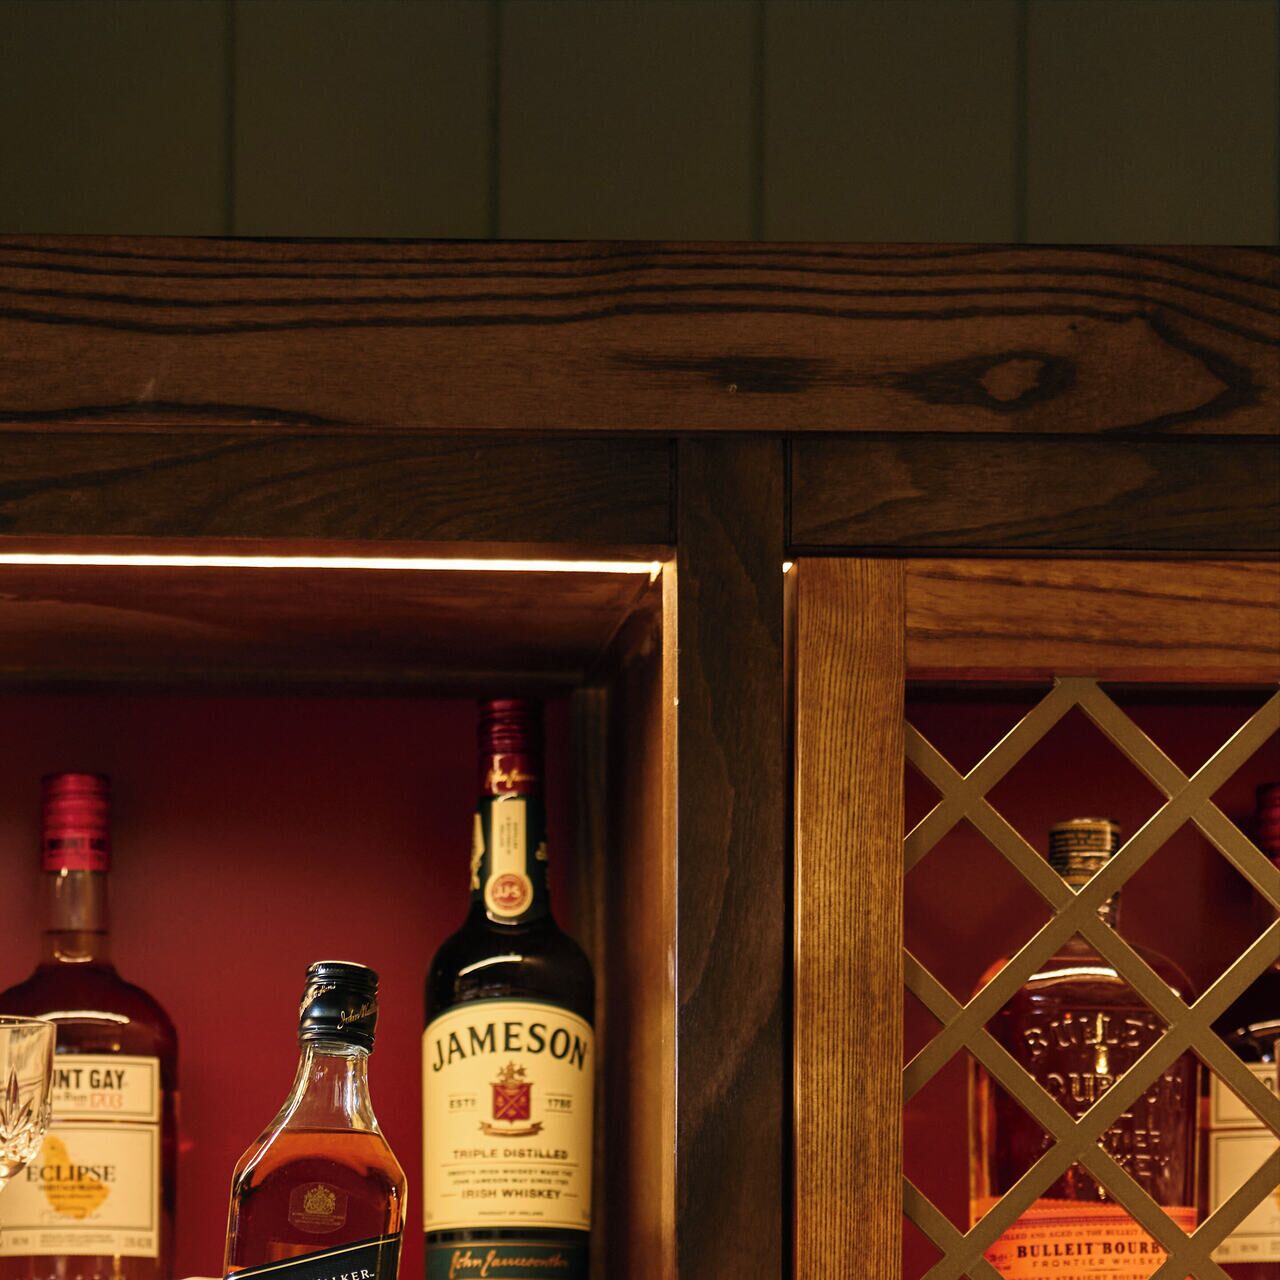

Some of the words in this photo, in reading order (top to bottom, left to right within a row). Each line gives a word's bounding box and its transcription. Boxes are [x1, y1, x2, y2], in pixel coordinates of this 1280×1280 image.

[432, 1022, 588, 1072] JAMESON
[89, 1070, 126, 1089] GAY
[453, 1148, 497, 1159] TRIPLE
[503, 1148, 569, 1160] DISTILLED
[26, 1165, 116, 1182] ECLIPSE
[461, 1189, 498, 1200] IRISH
[502, 1188, 562, 1200] WHISKEY
[1017, 1242, 1094, 1259] BULLEIT
[1102, 1241, 1162, 1255] BOURB
[1032, 1258, 1105, 1268] FRONTIER
[1112, 1258, 1162, 1266] WHISKE
